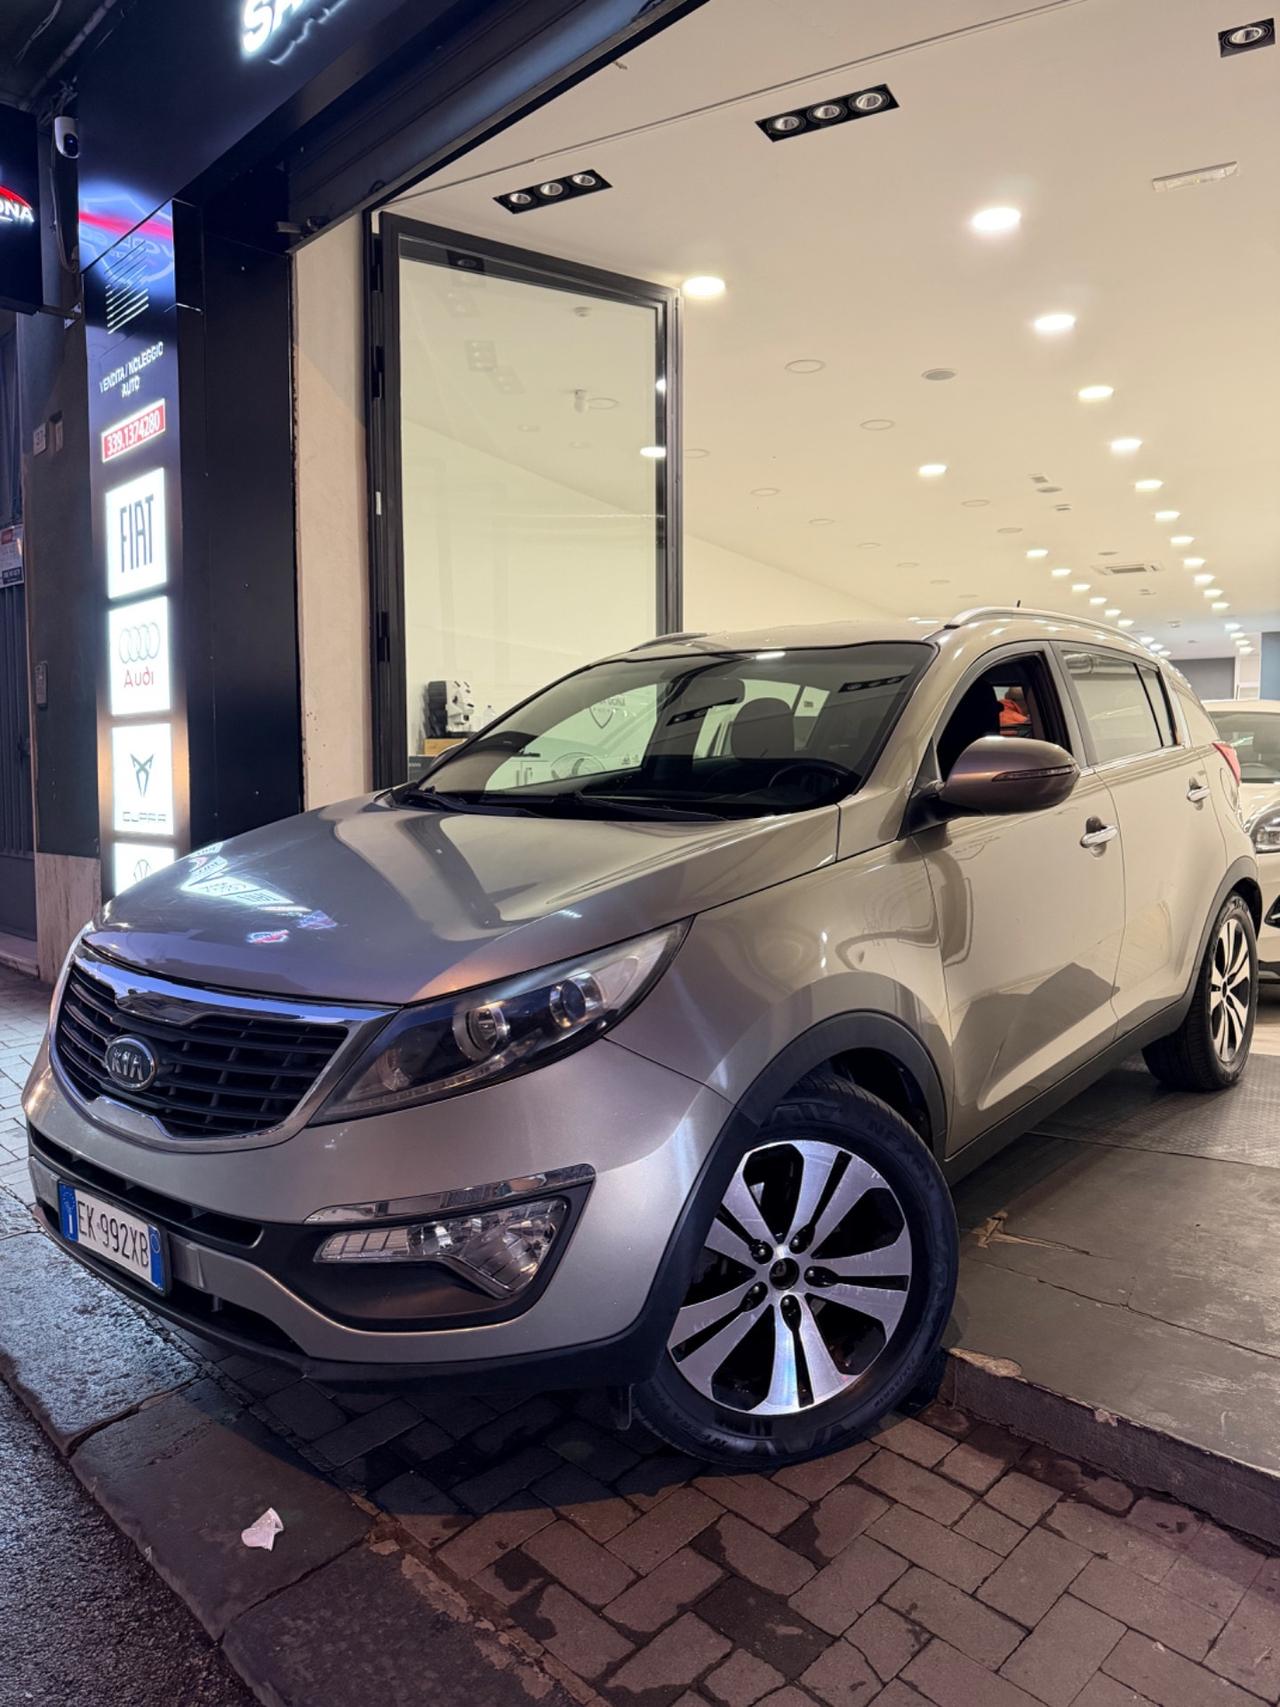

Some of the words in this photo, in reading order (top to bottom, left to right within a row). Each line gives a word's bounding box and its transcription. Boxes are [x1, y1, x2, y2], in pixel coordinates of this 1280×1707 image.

[121, 374, 141, 398] AUTO
[120, 494, 154, 573] FIAT
[123, 666, 154, 688] Audi
